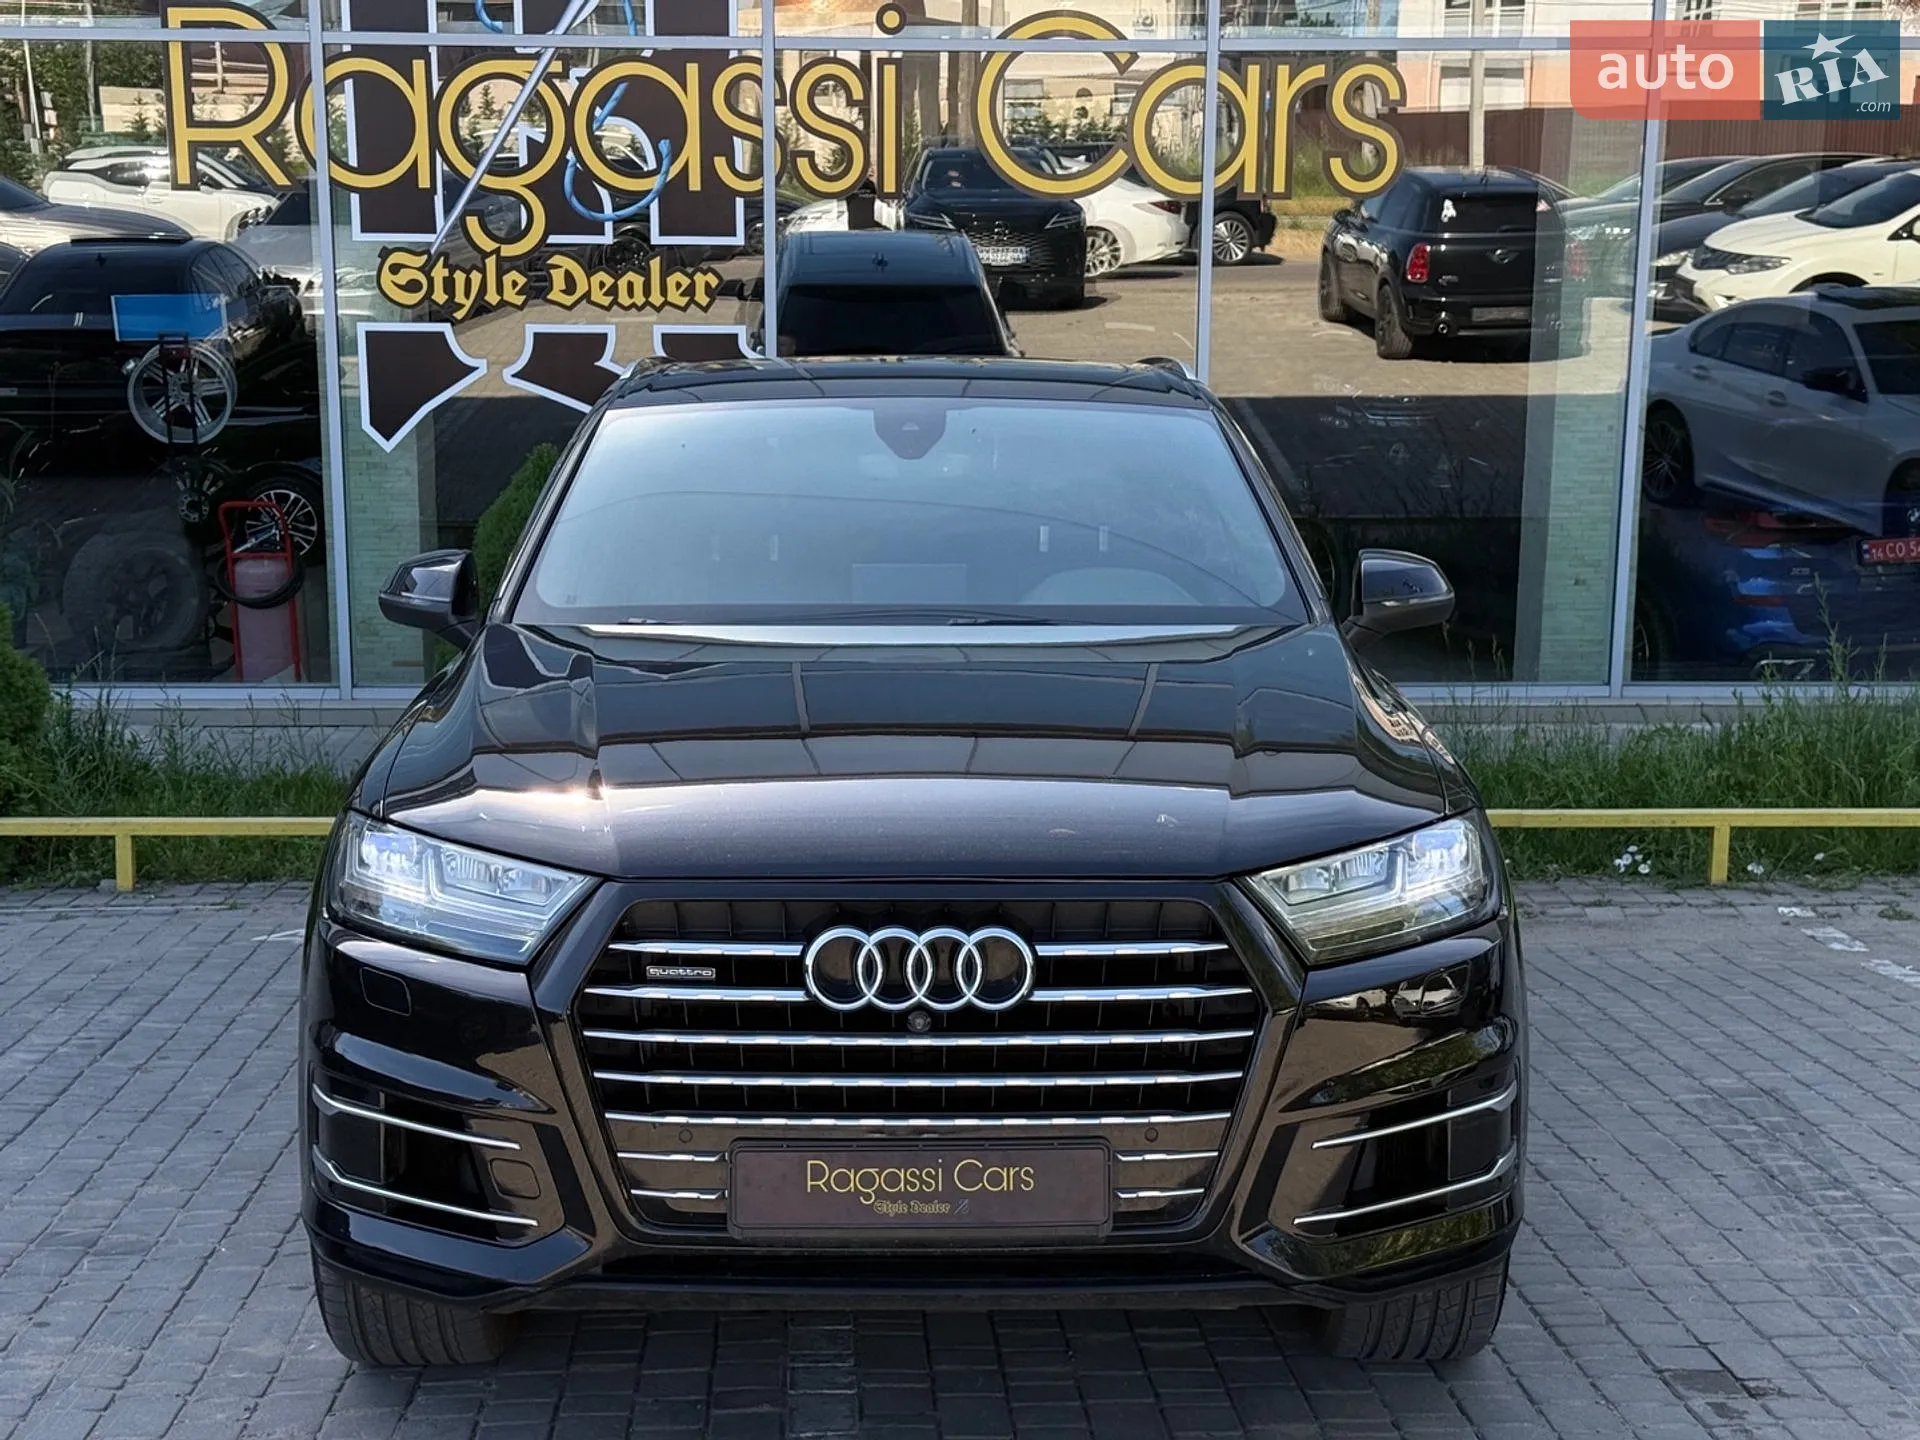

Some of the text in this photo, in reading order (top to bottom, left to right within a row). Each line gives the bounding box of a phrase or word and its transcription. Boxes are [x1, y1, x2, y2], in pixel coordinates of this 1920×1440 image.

[164, 3, 1405, 256] Ragassi Cars
[378, 248, 722, 322] Style Dealer
[1885, 541, 1906, 558] CO
[649, 967, 713, 977] quattro
[806, 1158, 1035, 1205] Ragassi Cars
